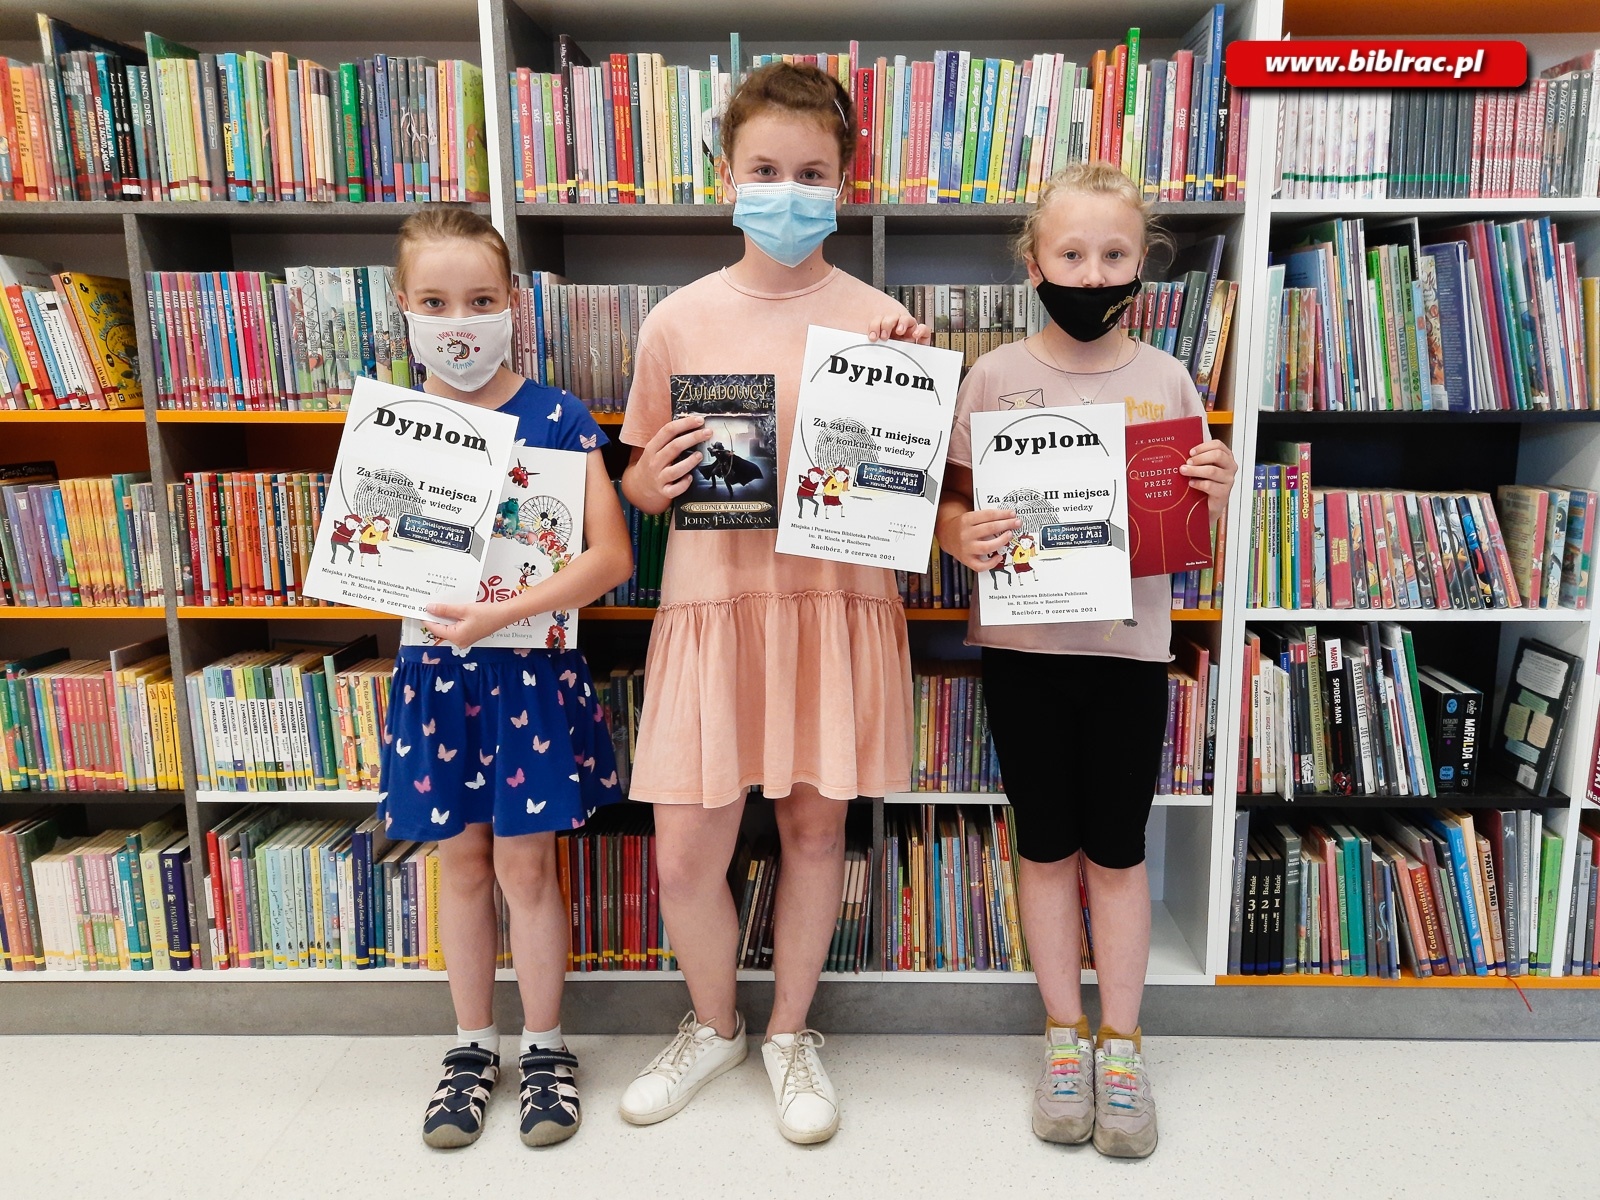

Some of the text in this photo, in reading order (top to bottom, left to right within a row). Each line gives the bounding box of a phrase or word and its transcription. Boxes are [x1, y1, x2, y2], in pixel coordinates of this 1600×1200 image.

[128, 71, 139, 126] NANCY DREW
[140, 71, 152, 126] NANCY DREW
[1265, 296, 1277, 384] KOMIKSY
[828, 355, 935, 391] Dyplom
[677, 380, 769, 402] ZWIADOWCY
[374, 407, 487, 451] Dyplom
[813, 418, 826, 428] Za
[870, 427, 882, 437] II
[885, 430, 931, 446] miejsca
[836, 437, 882, 452] konkursie
[884, 446, 915, 458] wiedzy
[994, 431, 1100, 456] Dyplom
[356, 466, 371, 478] Za
[418, 481, 426, 490] I
[428, 485, 477, 503] miejsca
[863, 472, 894, 485] Lassego
[1129, 467, 1179, 481] QUIDDITC
[1144, 479, 1172, 488] PRZEZ
[377, 486, 427, 505] konkursie
[430, 499, 462, 514] wiedzy
[987, 495, 1001, 504] Za
[1044, 490, 1059, 500] III
[1063, 488, 1110, 501] miejsca
[1144, 490, 1172, 499] WIEKI
[1062, 504, 1093, 513] wiedzy
[404, 522, 439, 538] Lassego
[683, 515, 771, 526] JOHN FLANAGAN
[1047, 532, 1079, 541] Lassego
[1085, 530, 1102, 538] Mai
[851, 550, 877, 559] czerwca
[879, 553, 895, 561] 2021
[387, 600, 416, 611] czerwca
[1308, 634, 1316, 657] MARVEL
[1330, 646, 1338, 669] MARVEL
[1332, 678, 1342, 724] SPIDER-MAN
[1462, 719, 1476, 759] MAFALDA
[1484, 855, 1494, 880] TATSU
[1249, 899, 1256, 911] 3
[1261, 900, 1269, 909] 2
[1415, 874, 1437, 949] Cudowna studzienka
